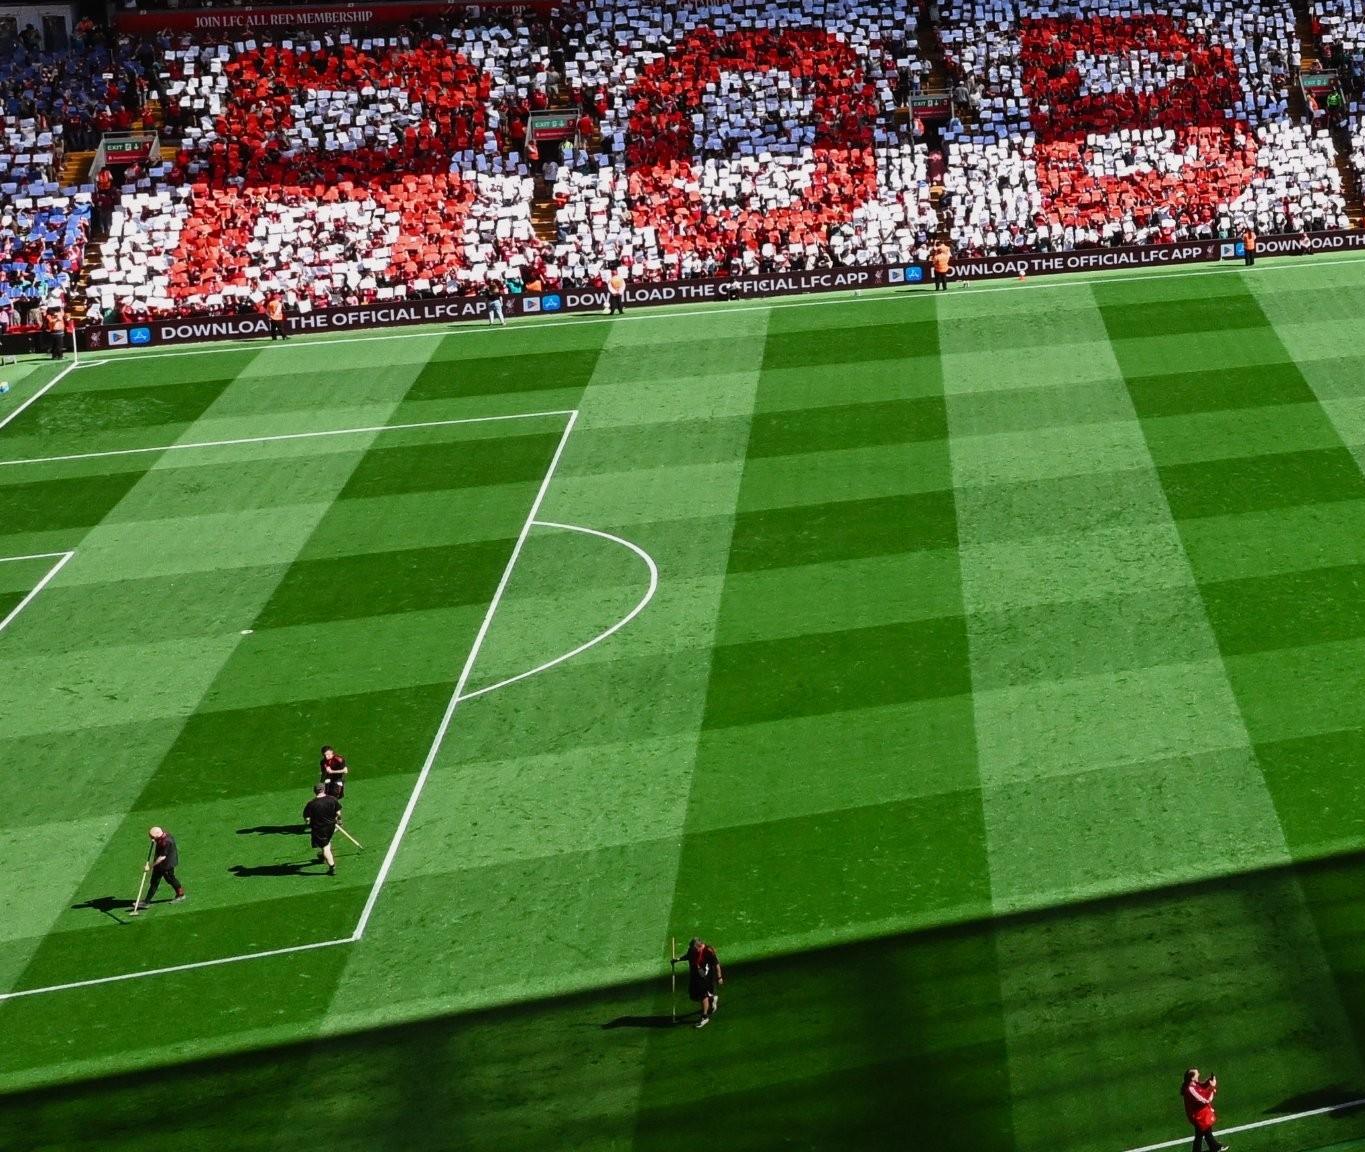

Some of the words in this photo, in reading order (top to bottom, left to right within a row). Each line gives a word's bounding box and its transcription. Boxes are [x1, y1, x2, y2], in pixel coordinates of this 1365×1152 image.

[195, 16, 219, 29] JOIN
[222, 15, 243, 28] LFC
[246, 14, 267, 27] ALL
[296, 10, 373, 25] MEMBERSHIP
[1256, 236, 1342, 253] DOWNOAD
[1031, 257, 1063, 270] THE
[1067, 251, 1137, 267] OFFICIAL
[1141, 249, 1167, 262] LFC
[1171, 246, 1201, 260] APP
[679, 283, 715, 298] THE
[801, 274, 831, 288] LFC
[834, 271, 868, 285] APP
[161, 318, 270, 340] DOWNLOA
[287, 314, 327, 329] THE
[332, 306, 420, 326] OFFICIAL
[425, 303, 458, 318] LFC
[462, 301, 486, 315] AP
